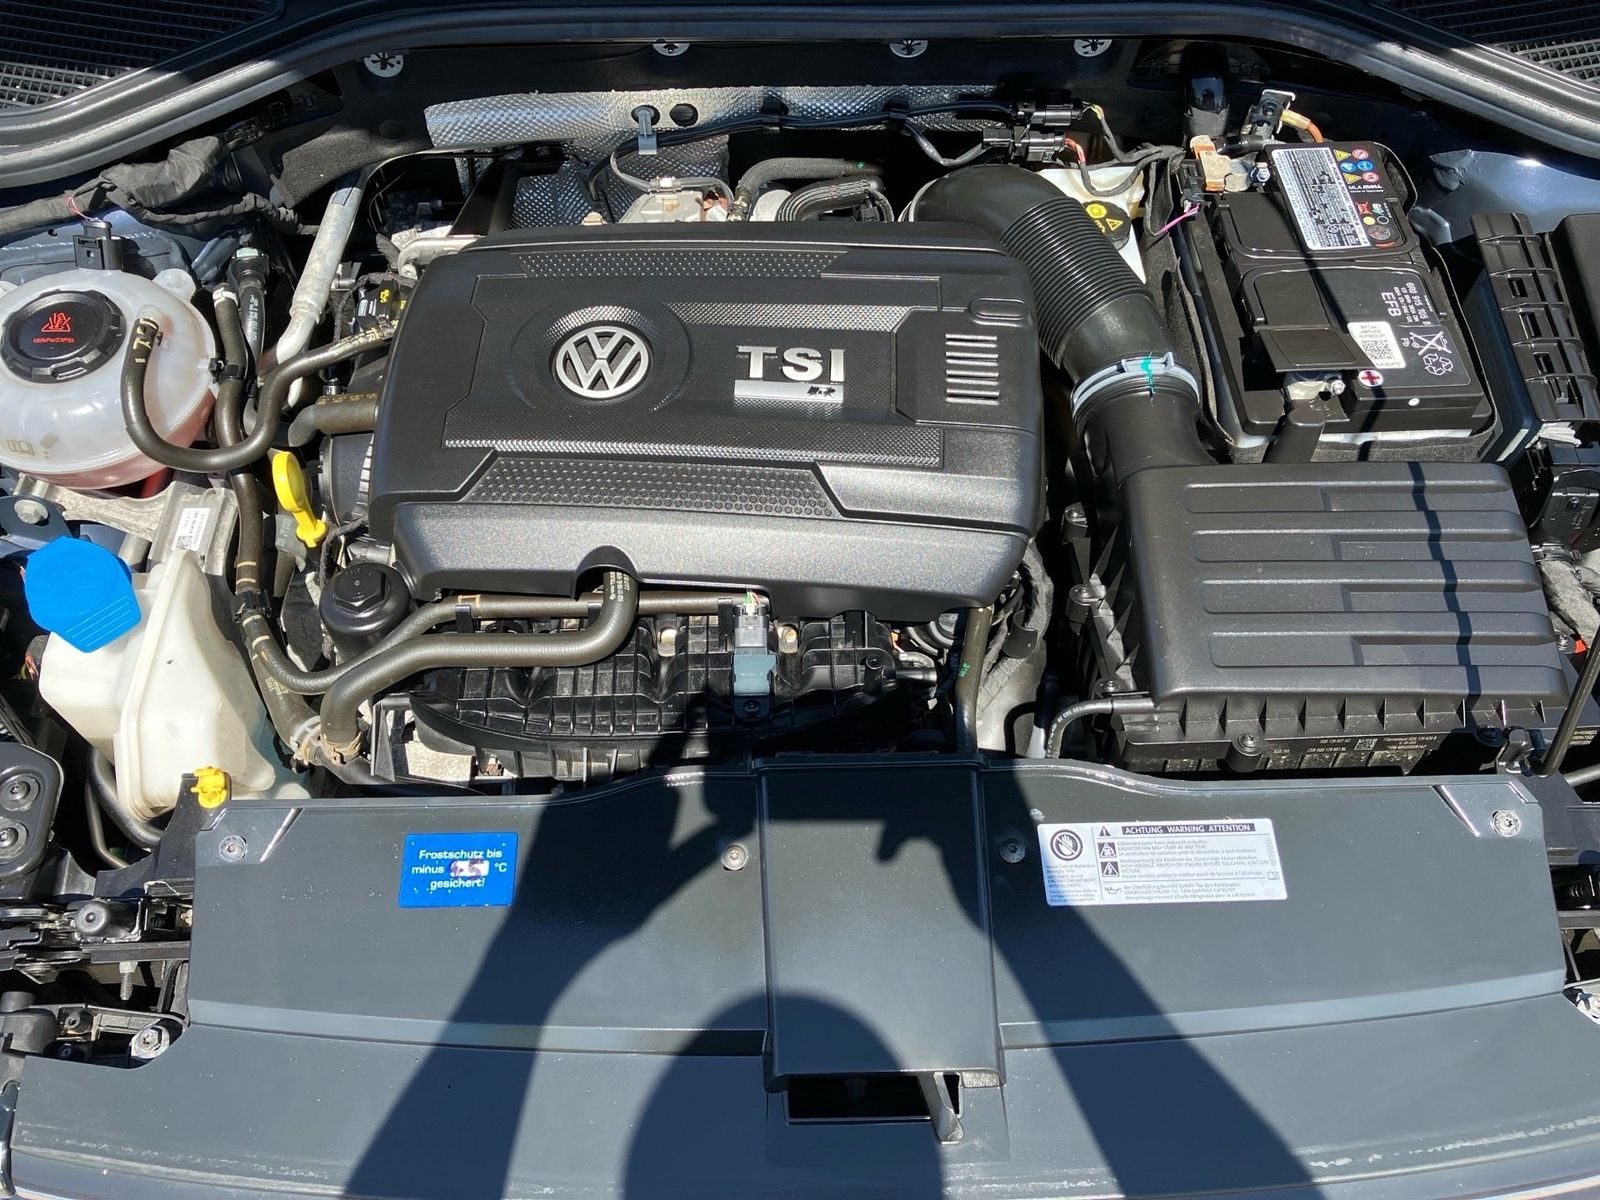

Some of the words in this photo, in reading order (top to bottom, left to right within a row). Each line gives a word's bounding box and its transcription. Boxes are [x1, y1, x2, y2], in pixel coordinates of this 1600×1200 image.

[1381, 292, 1402, 317] EFB
[556, 327, 649, 399] VW
[736, 345, 846, 382] TSI
[1125, 826, 1163, 834] ACHTUNG
[1167, 825, 1205, 833] WARNING
[1208, 824, 1251, 832] ATTENTION
[419, 849, 484, 859] Frostschutz
[487, 848, 502, 858] bis
[412, 865, 445, 874] minus
[494, 862, 508, 872] °C
[430, 878, 485, 891] gesichert!
